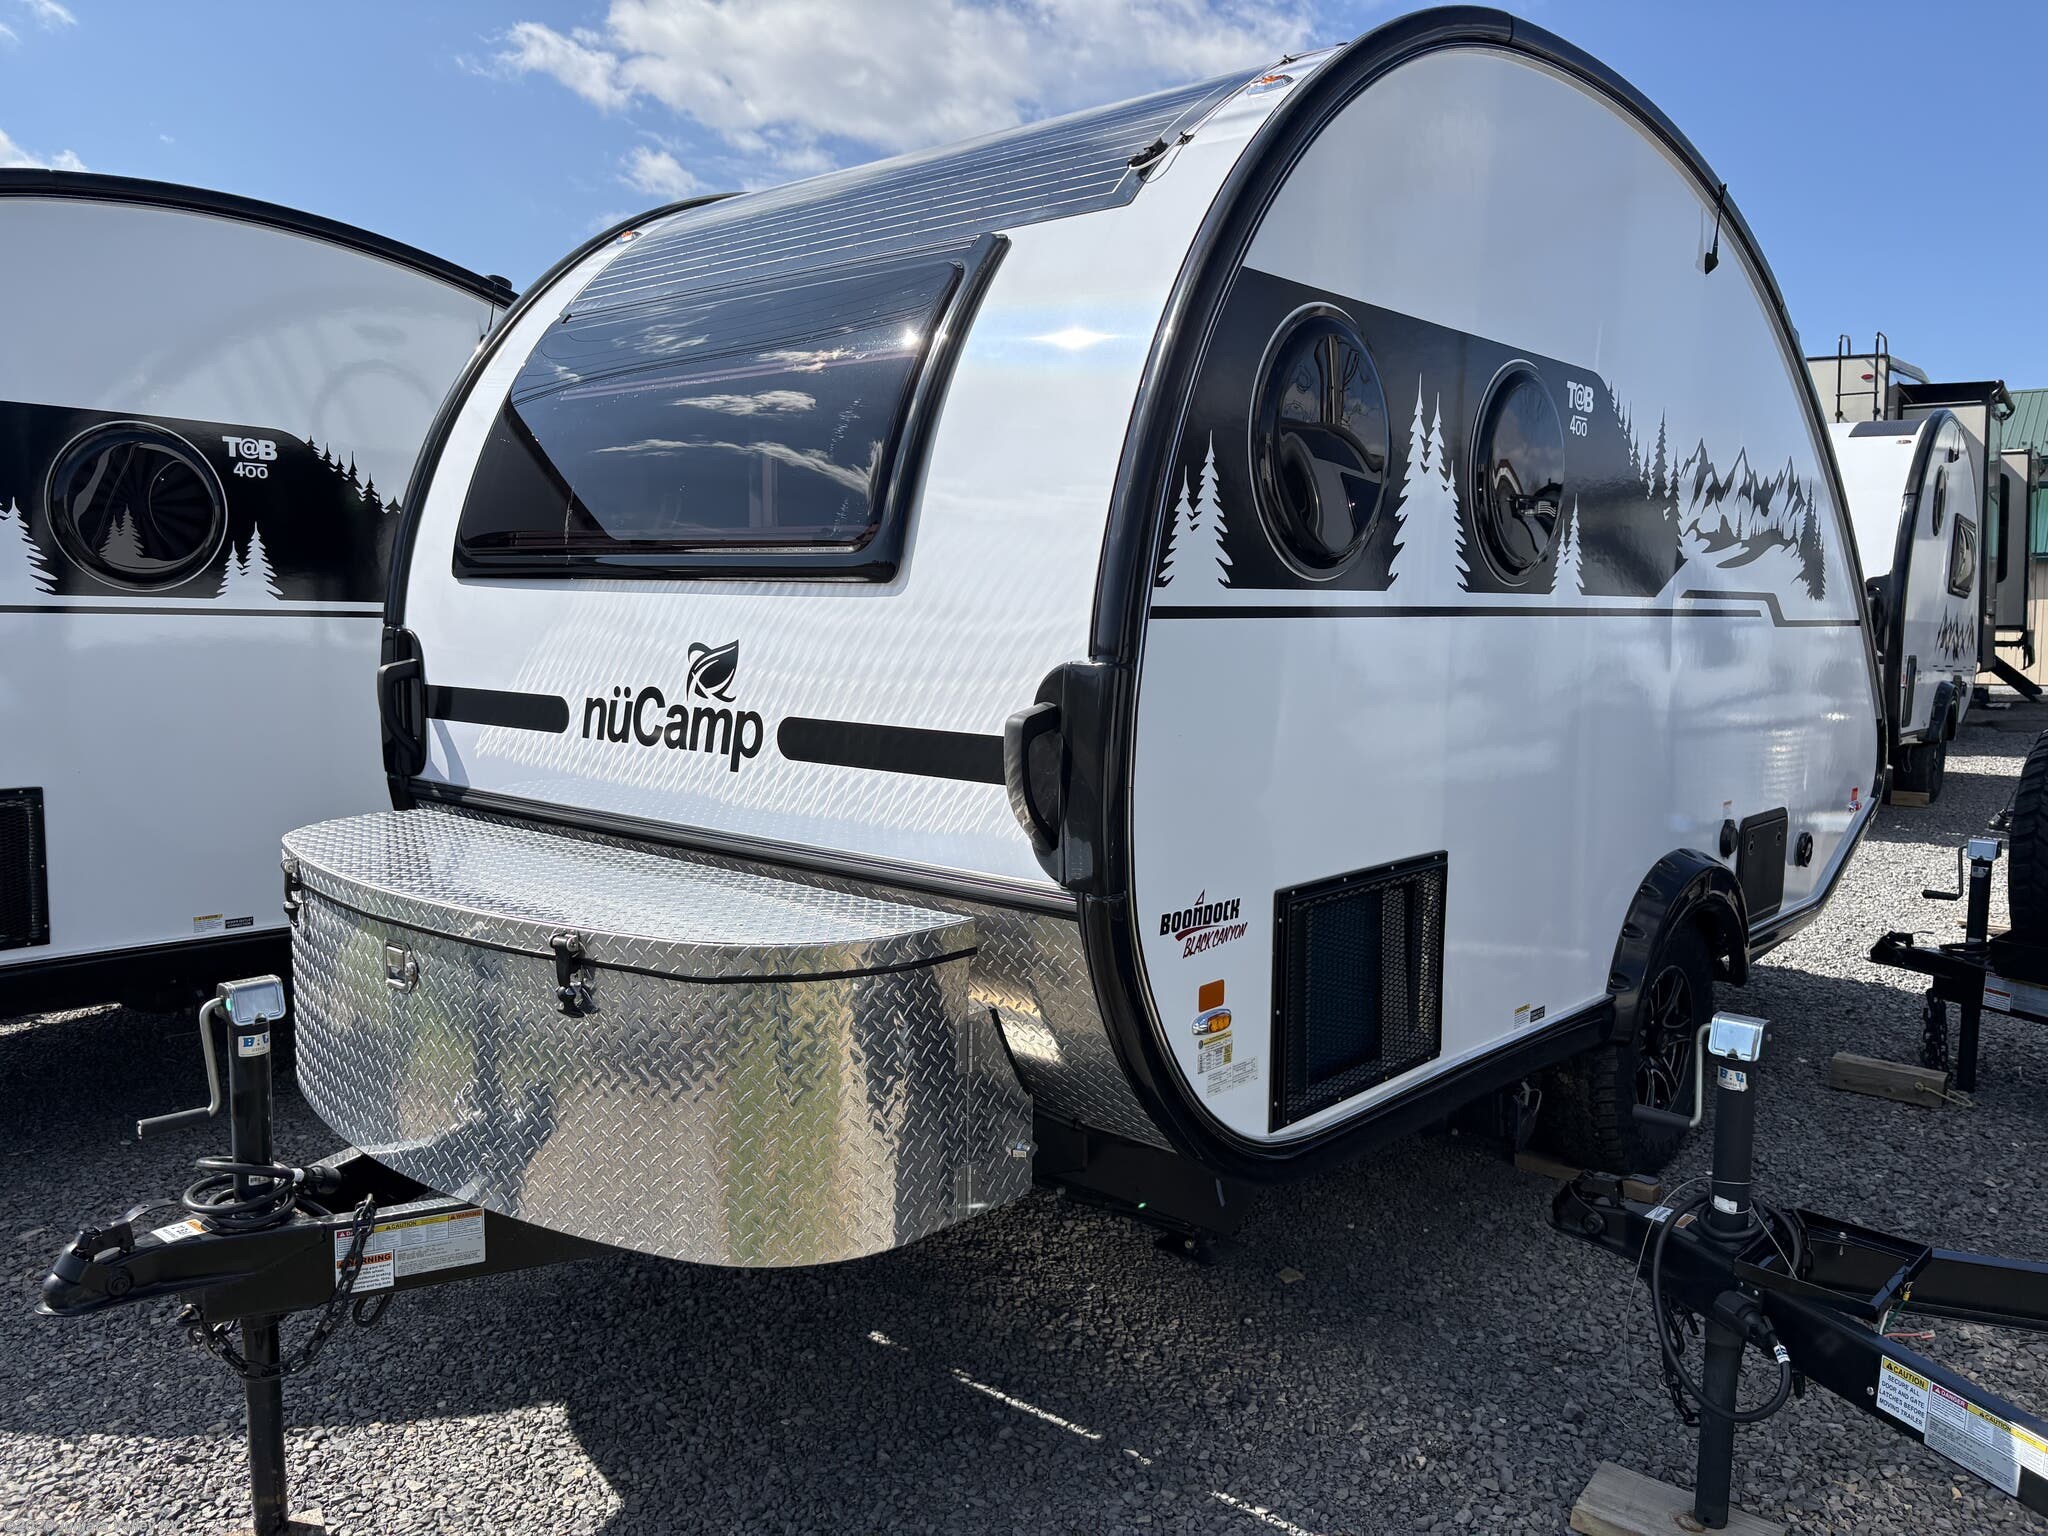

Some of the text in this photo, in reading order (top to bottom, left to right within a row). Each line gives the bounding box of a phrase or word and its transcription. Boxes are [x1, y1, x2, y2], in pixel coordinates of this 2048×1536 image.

[1567, 381, 1594, 413] T@B
[1570, 414, 1588, 437] 400
[222, 435, 278, 461] T@B
[233, 461, 269, 479] 400
[582, 685, 764, 773] nüCamp
[1159, 898, 1241, 936] BOONDOCK
[1182, 922, 1248, 959] BLACK CANYON
[391, 1219, 417, 1230] CAUTION
[1888, 1374, 1920, 1397] SECURE ALL
[1893, 1366, 1926, 1389] CAUTION
[1879, 1388, 1903, 1406] LATCHES
[1903, 1401, 1925, 1419] BEFORE
[1881, 1380, 1925, 1409] DOOR AND GATE
[1941, 1388, 1967, 1408] DANGER
[1880, 1397, 1900, 1413] MOVING
[1900, 1409, 1923, 1427] TRAILER
[1983, 1413, 2012, 1433] CAUTION
